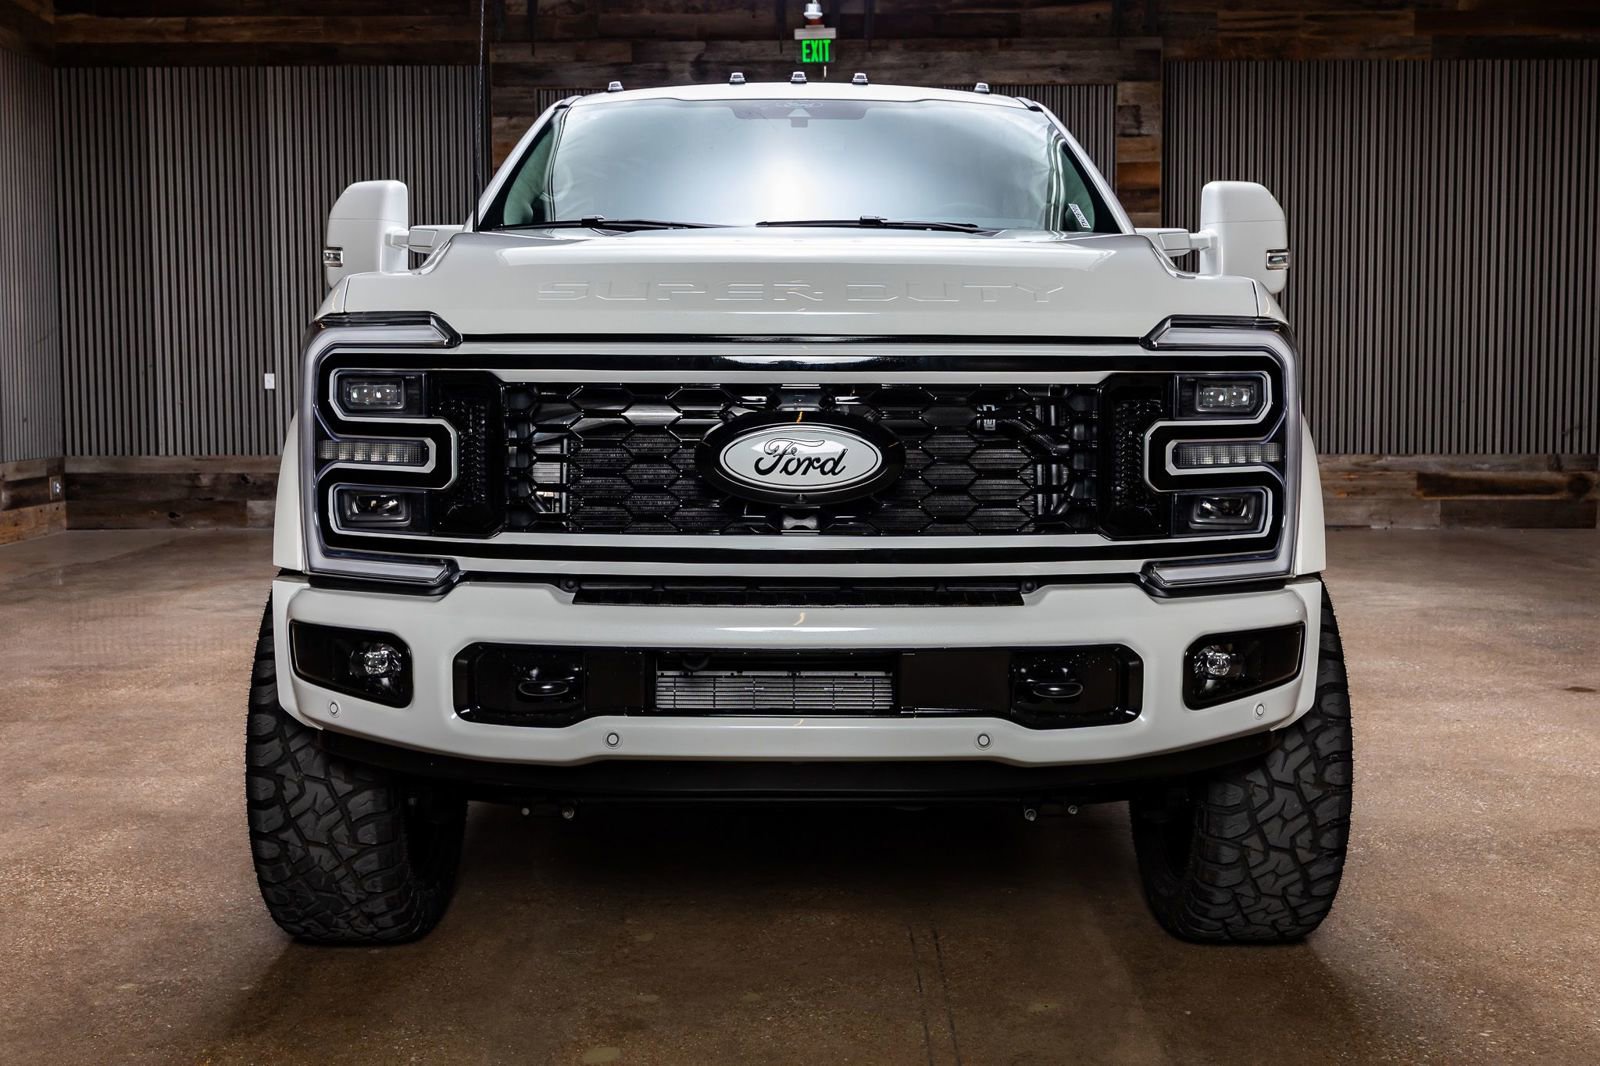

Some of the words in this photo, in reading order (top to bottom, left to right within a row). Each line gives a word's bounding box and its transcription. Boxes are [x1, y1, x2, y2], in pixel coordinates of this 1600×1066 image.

[802, 39, 831, 63] EXIT
[536, 281, 823, 301] SUPER
[844, 281, 1064, 303] DUTY
[754, 437, 848, 476] Ford
